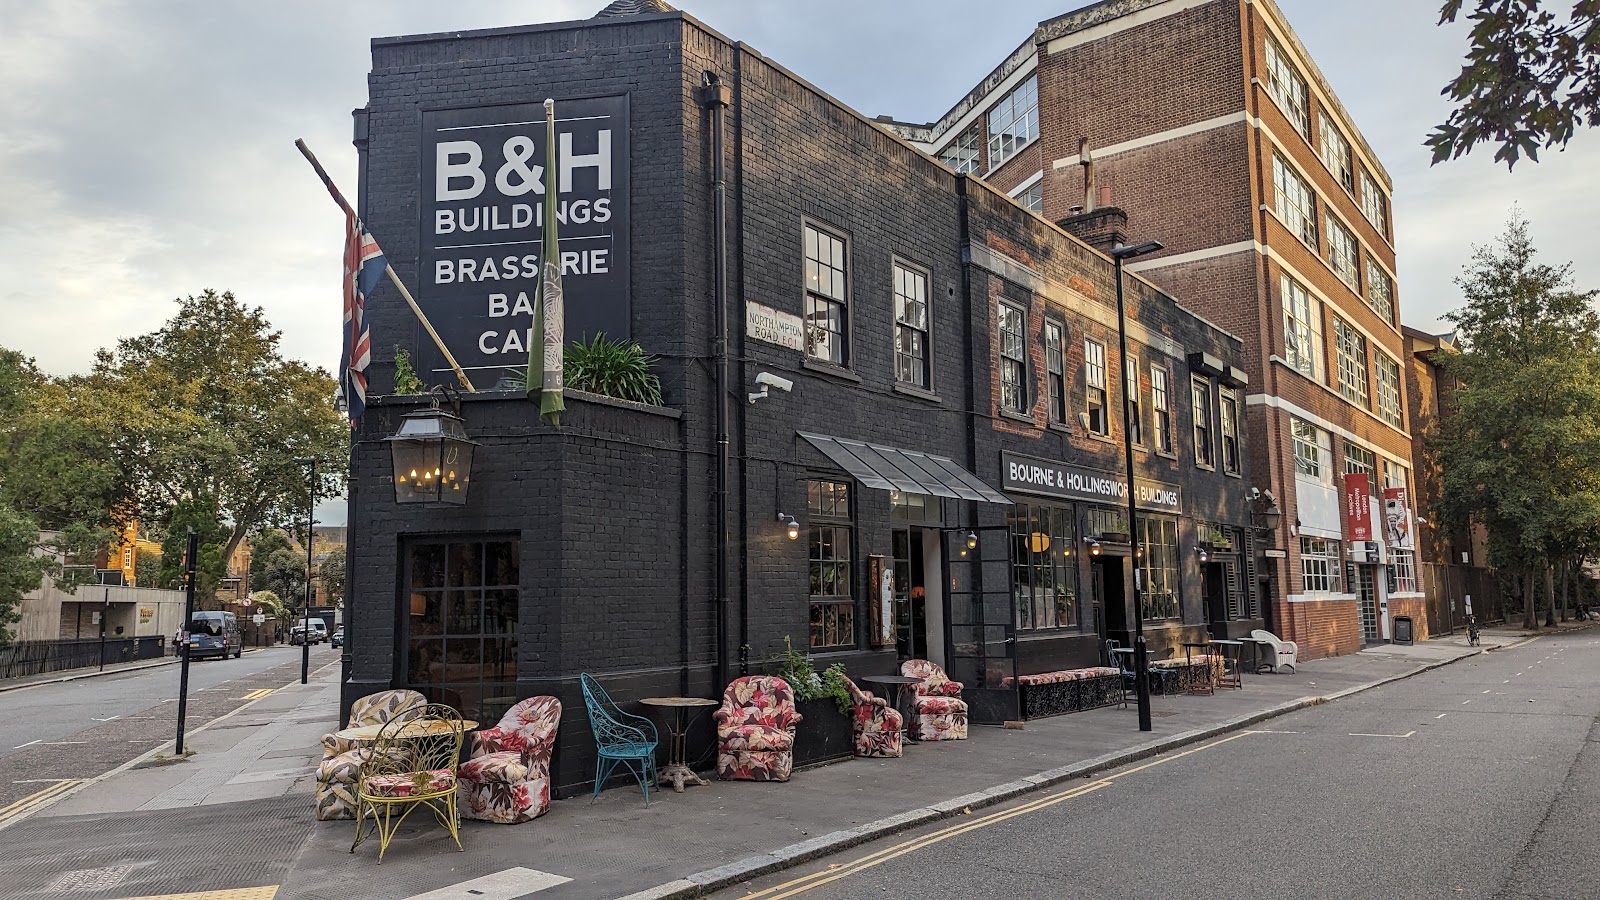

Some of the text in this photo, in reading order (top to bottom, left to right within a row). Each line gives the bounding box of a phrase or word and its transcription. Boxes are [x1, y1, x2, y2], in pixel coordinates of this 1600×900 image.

[435, 249, 609, 284] BRASSRIE
[488, 291, 534, 318] BA
[749, 313, 801, 337] NORTHAMPTON
[1010, 462, 1177, 506] BOURNE & HOLLINGSWORH BUILDINGS
